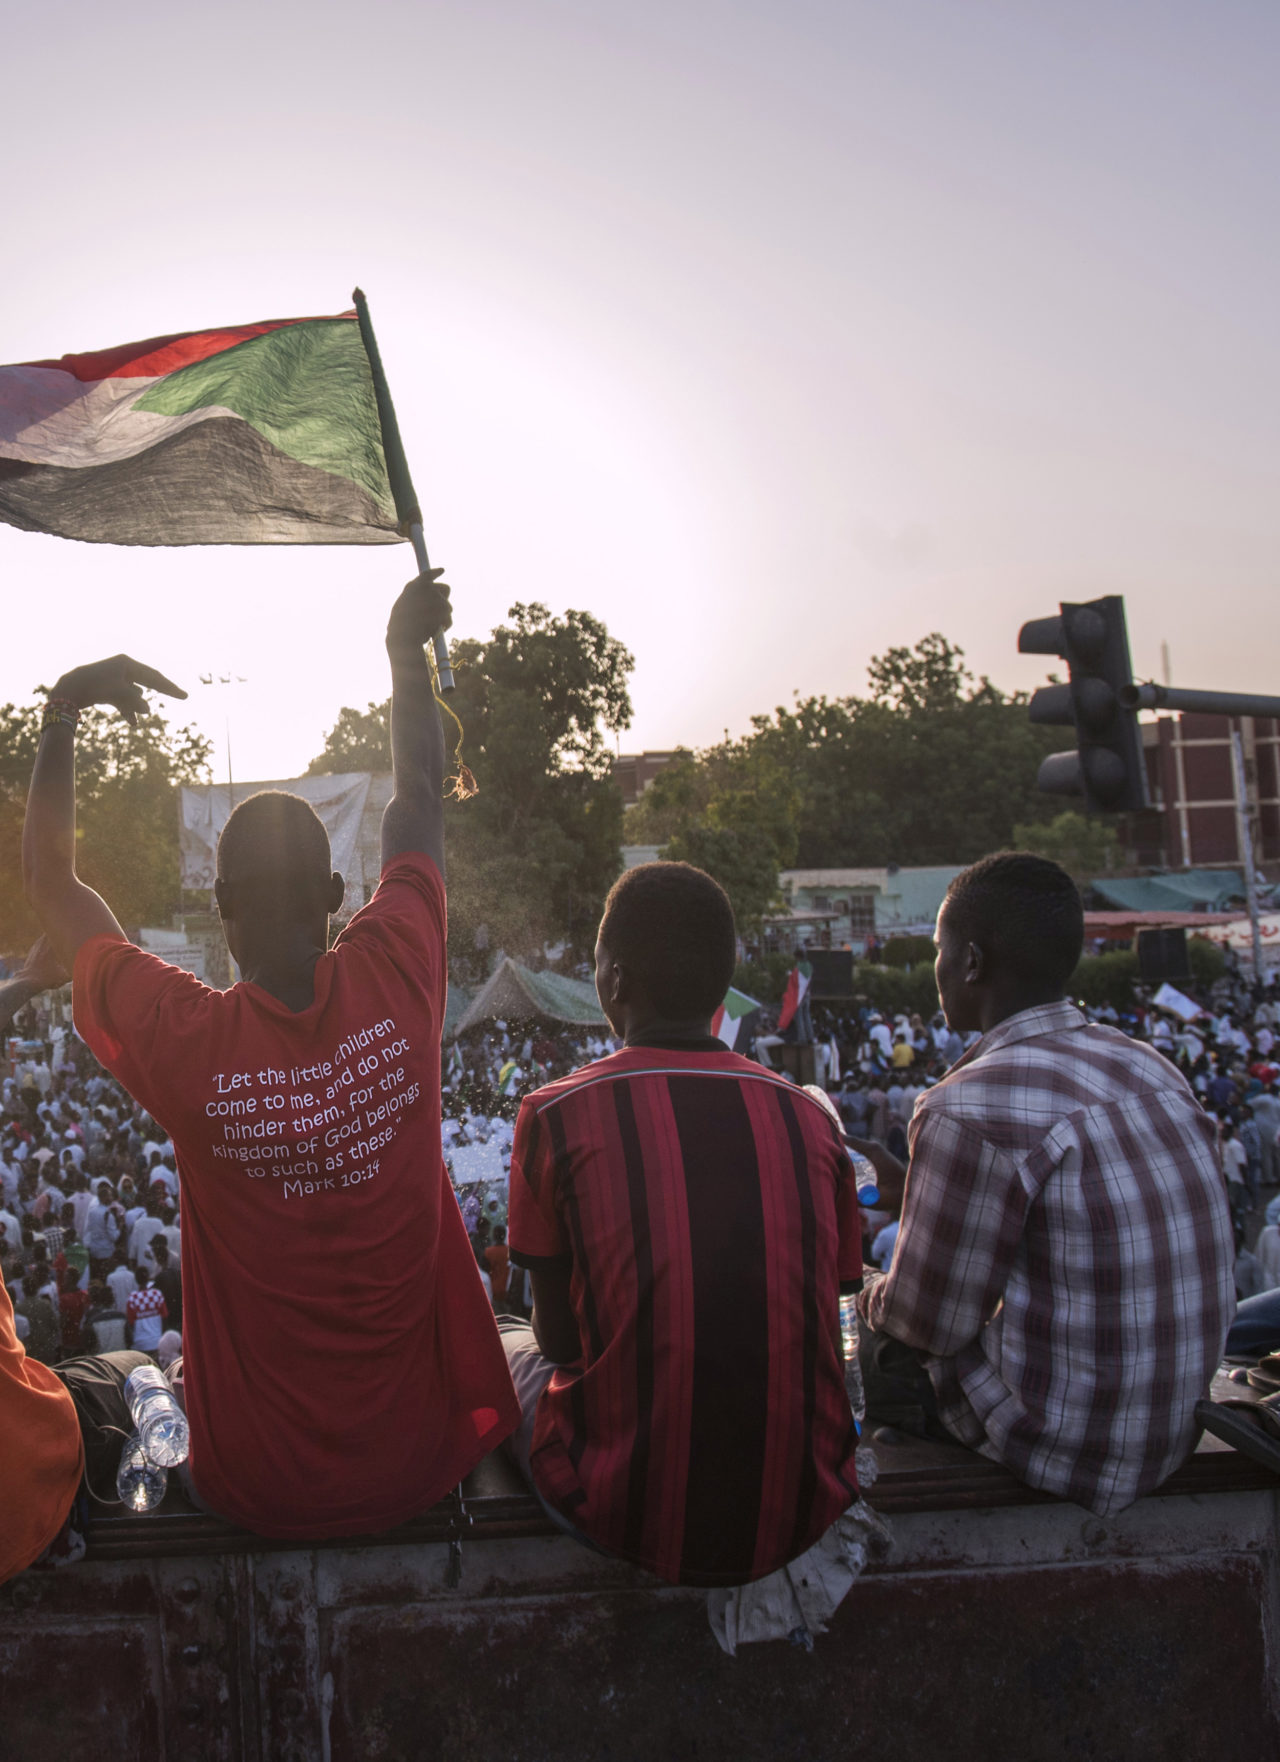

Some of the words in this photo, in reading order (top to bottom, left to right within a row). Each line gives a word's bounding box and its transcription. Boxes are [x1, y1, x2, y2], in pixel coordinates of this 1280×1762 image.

[206, 1098, 257, 1117] come
[263, 1095, 285, 1110] to
[290, 1093, 320, 1110] me,
[326, 1066, 355, 1100] and
[358, 1055, 379, 1076] do
[381, 1038, 410, 1063] not
[257, 1067, 286, 1086] the
[291, 1062, 332, 1087] little
[335, 1018, 395, 1066] children
[212, 1144, 290, 1162] kingdom
[296, 1136, 319, 1154] of
[325, 1115, 362, 1148] God
[366, 1082, 420, 1128] belongs
[224, 1119, 287, 1140] hinder
[292, 1106, 345, 1132] them,
[349, 1086, 375, 1113] for
[379, 1067, 405, 1091] the
[246, 1167, 265, 1178] to
[272, 1160, 319, 1177] such
[325, 1152, 344, 1171] as
[283, 1178, 336, 1200] Mark
[341, 1159, 380, 1188] 10:14
